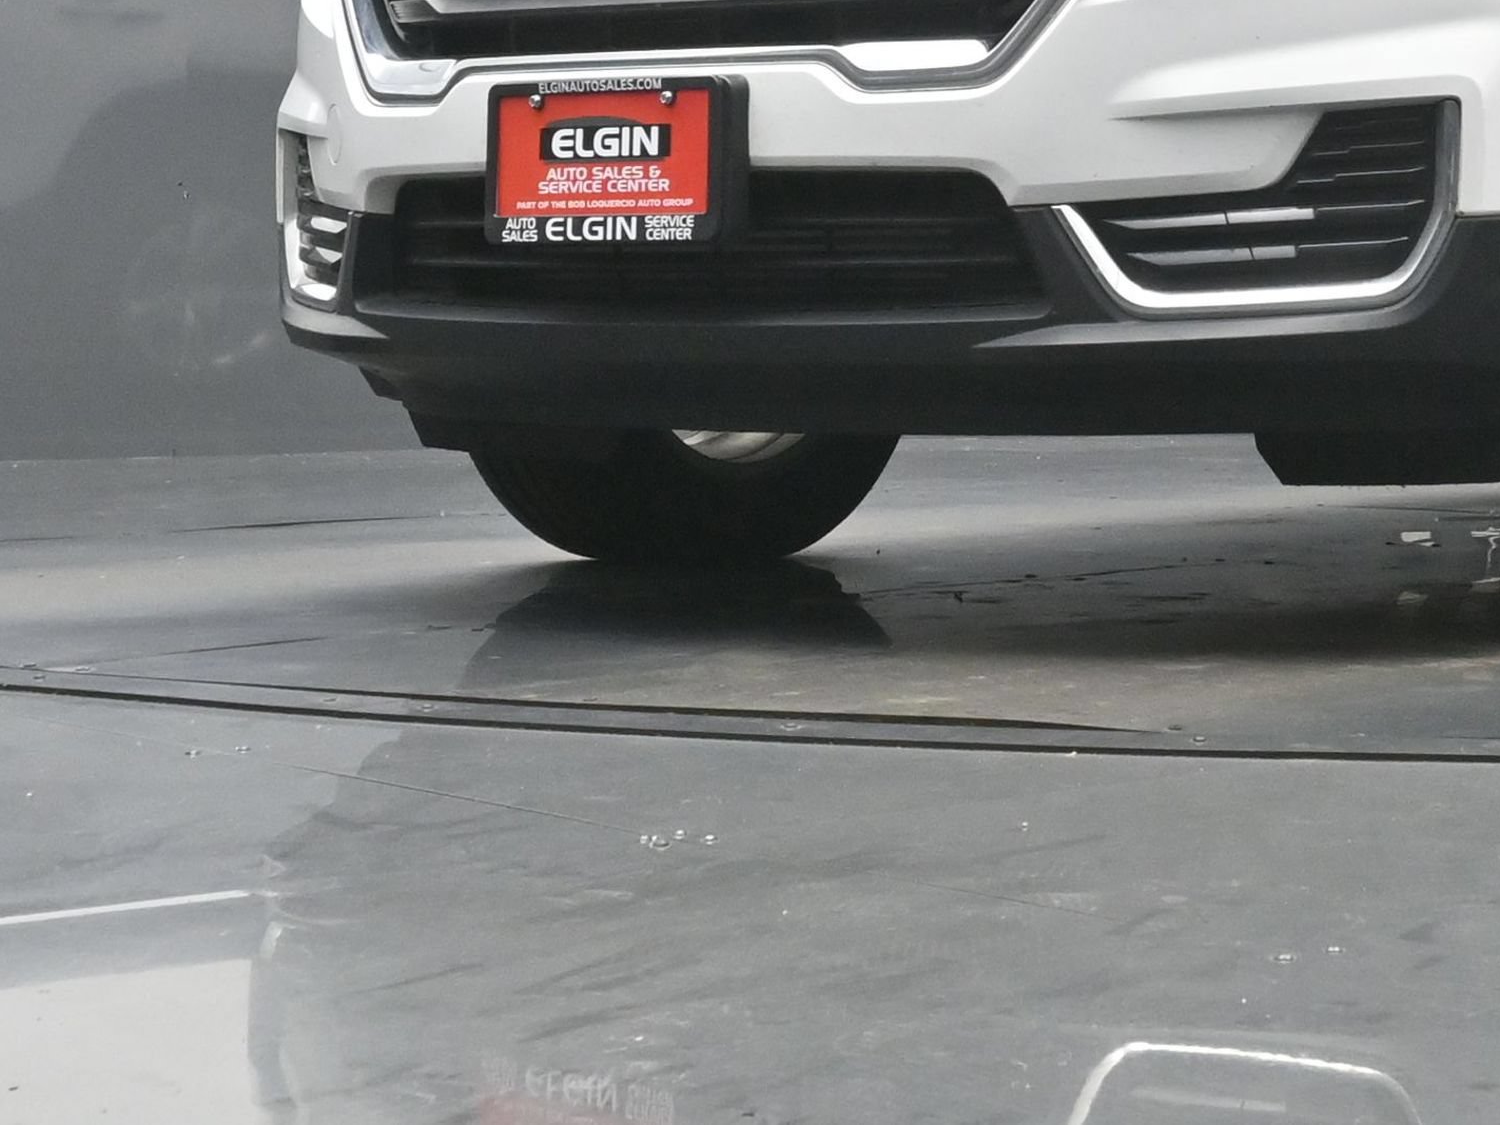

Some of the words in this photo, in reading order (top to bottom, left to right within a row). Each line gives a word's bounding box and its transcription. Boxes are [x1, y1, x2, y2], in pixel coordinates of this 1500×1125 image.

[538, 78, 662, 94] ELGINAUTOSALES.COM
[551, 126, 659, 158] ELGIN
[546, 167, 587, 181] AUTO
[592, 166, 643, 180] SALES
[649, 165, 661, 178] &
[538, 180, 602, 195] SERVICE
[607, 178, 670, 192] CENTER
[516, 200, 536, 209] PART
[537, 200, 550, 209] OF
[551, 200, 567, 209] THE
[637, 198, 661, 207] AUTO
[662, 197, 694, 207] GROUP
[505, 217, 537, 230] AUTO
[545, 216, 637, 242] ELGIN
[645, 215, 695, 228] SERVICE
[501, 229, 538, 242] SALES
[646, 227, 692, 241] CENTER
